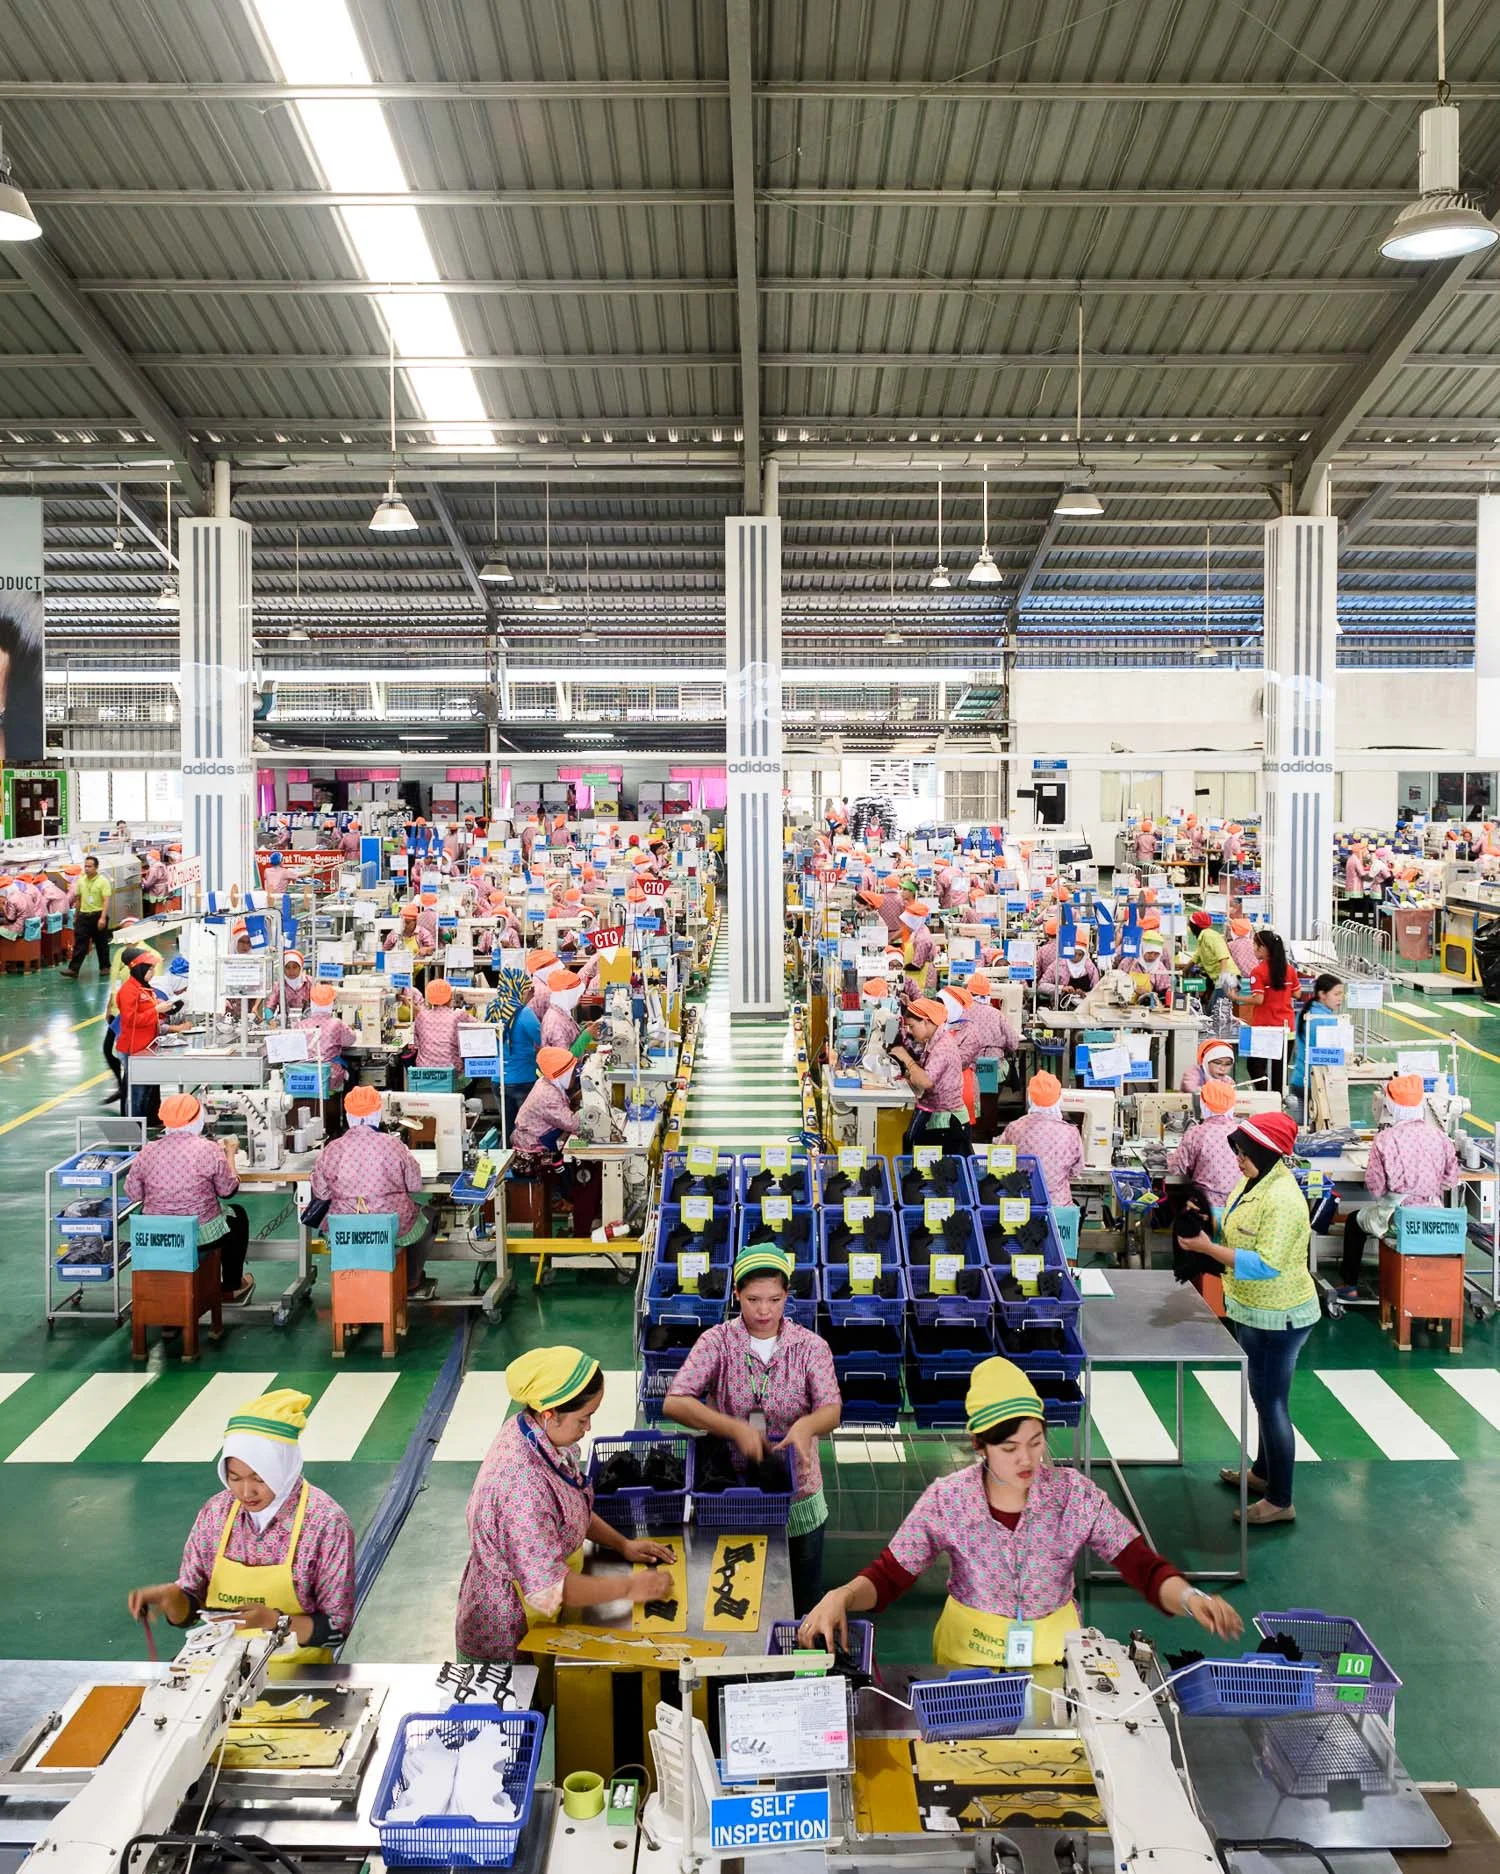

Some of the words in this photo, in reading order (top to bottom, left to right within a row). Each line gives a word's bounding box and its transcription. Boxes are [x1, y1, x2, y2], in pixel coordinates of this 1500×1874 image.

[183, 762, 235, 774] adidas
[729, 760, 781, 773] adidas
[1280, 760, 1333, 772] adidas
[256, 854, 271, 865] Righ
[643, 882, 664, 894] CTQ
[594, 931, 618, 947] CTQ
[1406, 1221, 1420, 1235] SELF
[1422, 1221, 1460, 1235] INSPECTION
[135, 1232, 149, 1246] SELF
[150, 1233, 185, 1248] INSPECTION
[335, 1231, 350, 1245] SELF
[352, 1231, 389, 1245] INSPECTION
[1345, 1658, 1365, 1674] 10
[750, 1795, 796, 1818] SELF
[714, 1819, 826, 1846] INSPECTION
